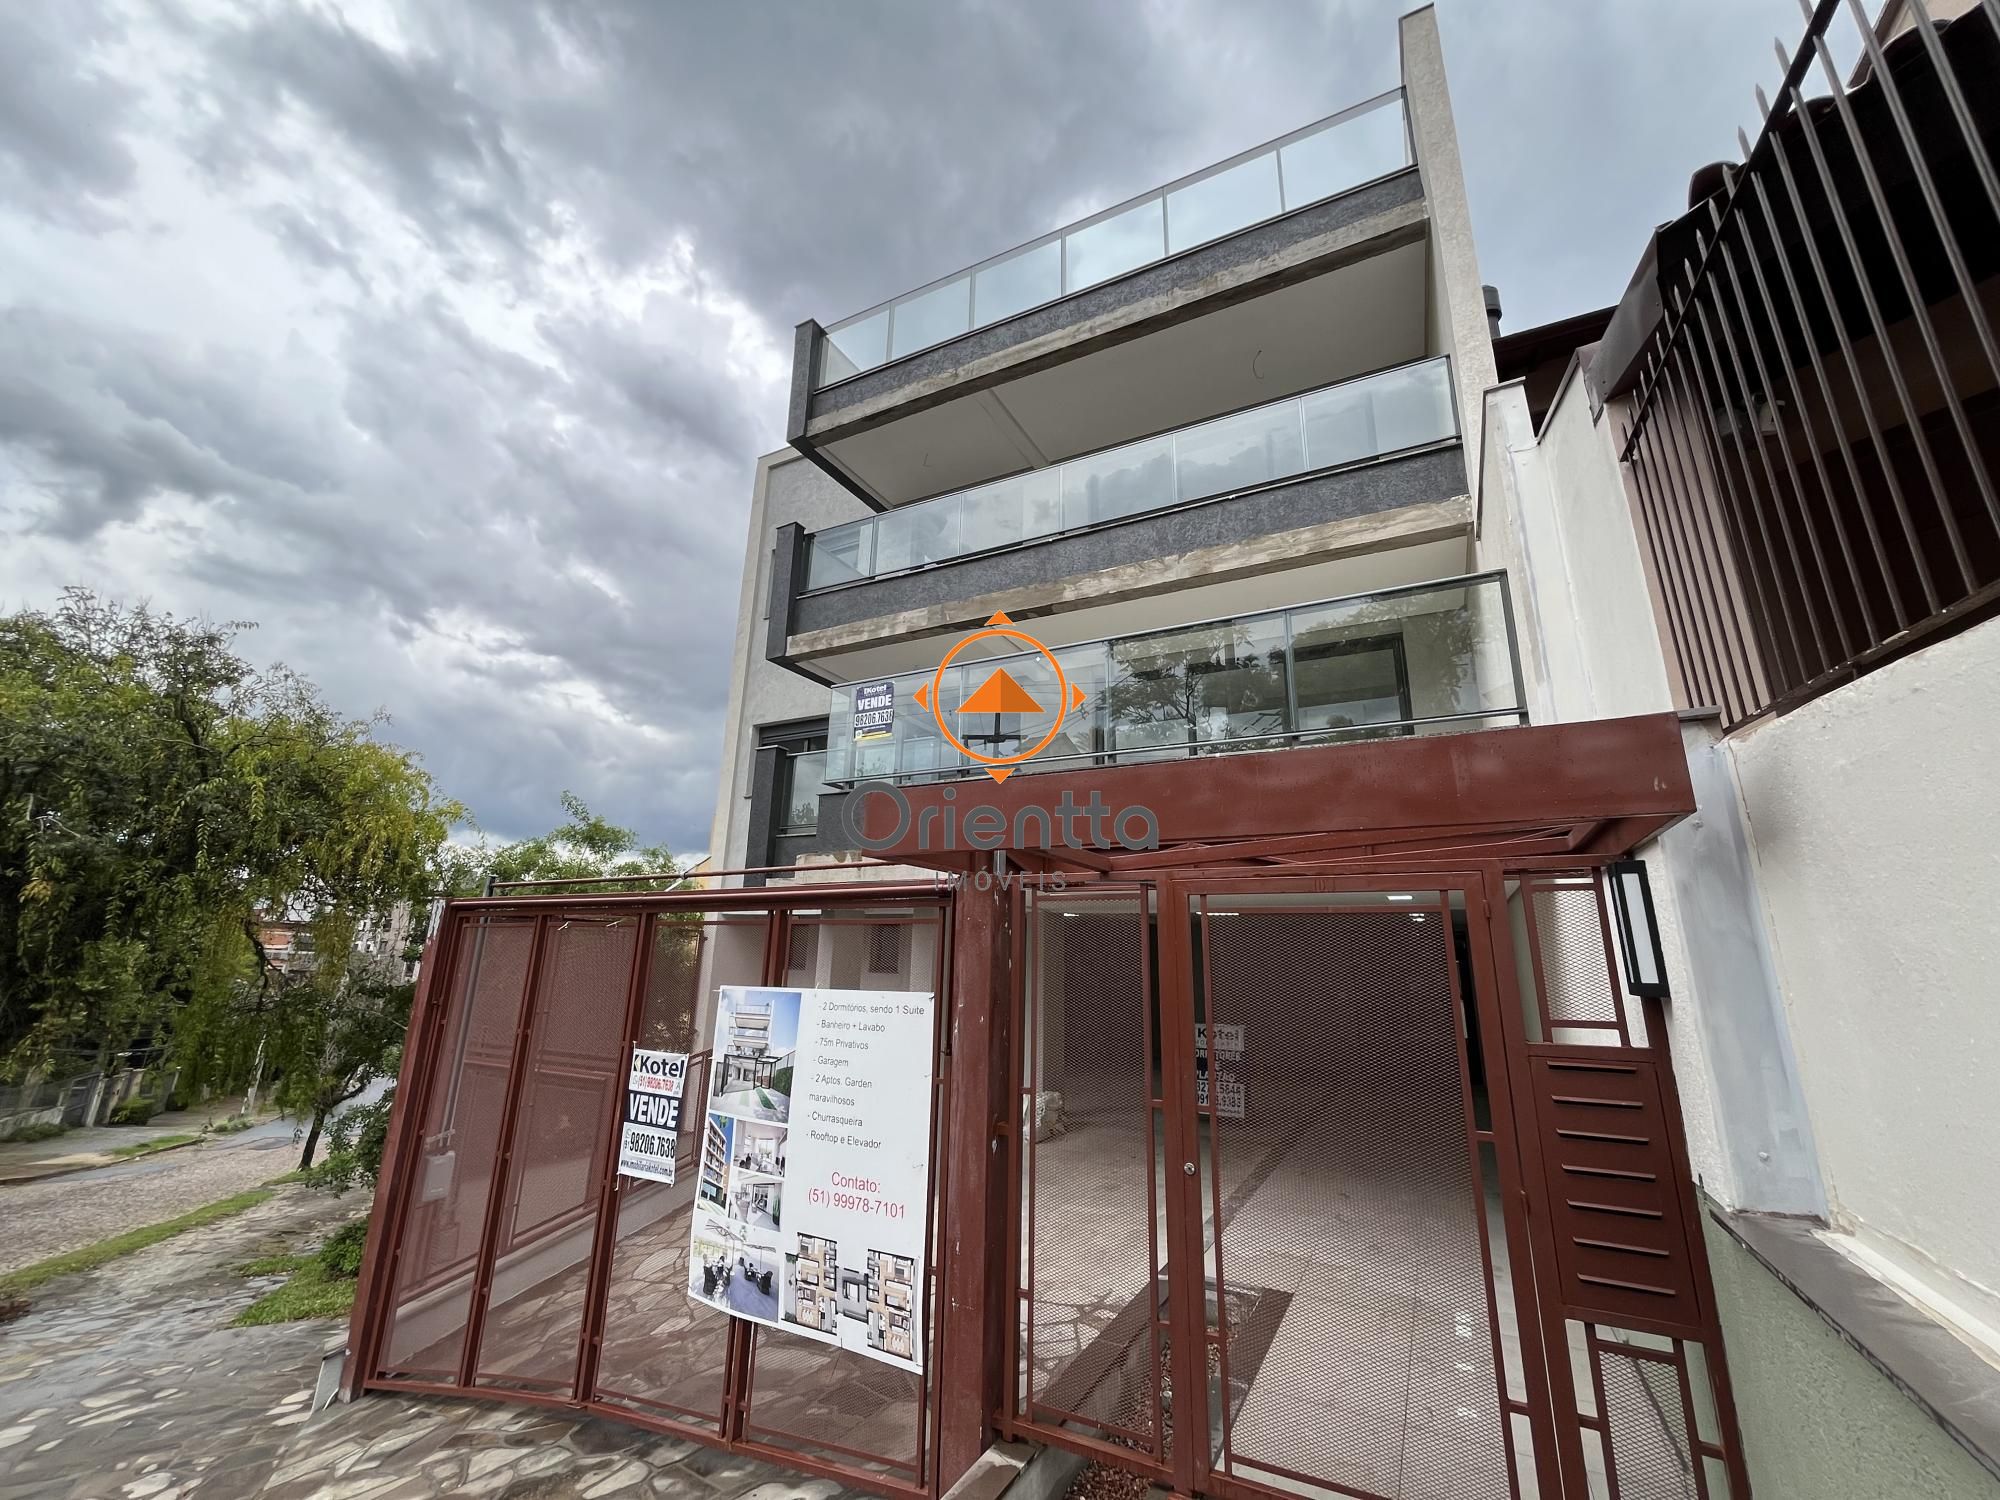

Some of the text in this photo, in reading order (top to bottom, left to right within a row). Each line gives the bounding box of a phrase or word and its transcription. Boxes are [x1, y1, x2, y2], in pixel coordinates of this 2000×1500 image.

[857, 695, 892, 710] VENDE
[822, 1002, 827, 1011] 2
[870, 1005, 893, 1014] sendo
[896, 1005, 900, 1014] 1
[821, 1019, 851, 1030] Banheiro
[858, 1022, 886, 1032] Lavabo
[1197, 1027, 1240, 1040] Ktel
[819, 1037, 834, 1047] 75m
[835, 1038, 869, 1050] Privativos
[639, 1055, 685, 1078] Kotel
[817, 1055, 849, 1068] Garagem
[815, 1073, 821, 1083] 2
[844, 1077, 873, 1089] Garden
[808, 1093, 855, 1106] maravilhosos
[629, 1093, 679, 1128] VENDE
[811, 1110, 863, 1127] Churrasqueira
[629, 1131, 676, 1159] 98206.7638
[810, 1129, 839, 1144] Rooftop
[840, 1136, 845, 1144] e
[847, 1135, 882, 1149] Elevador
[831, 1171, 881, 1194] Contato:
[808, 1187, 905, 1220] (51) 99978-7101
